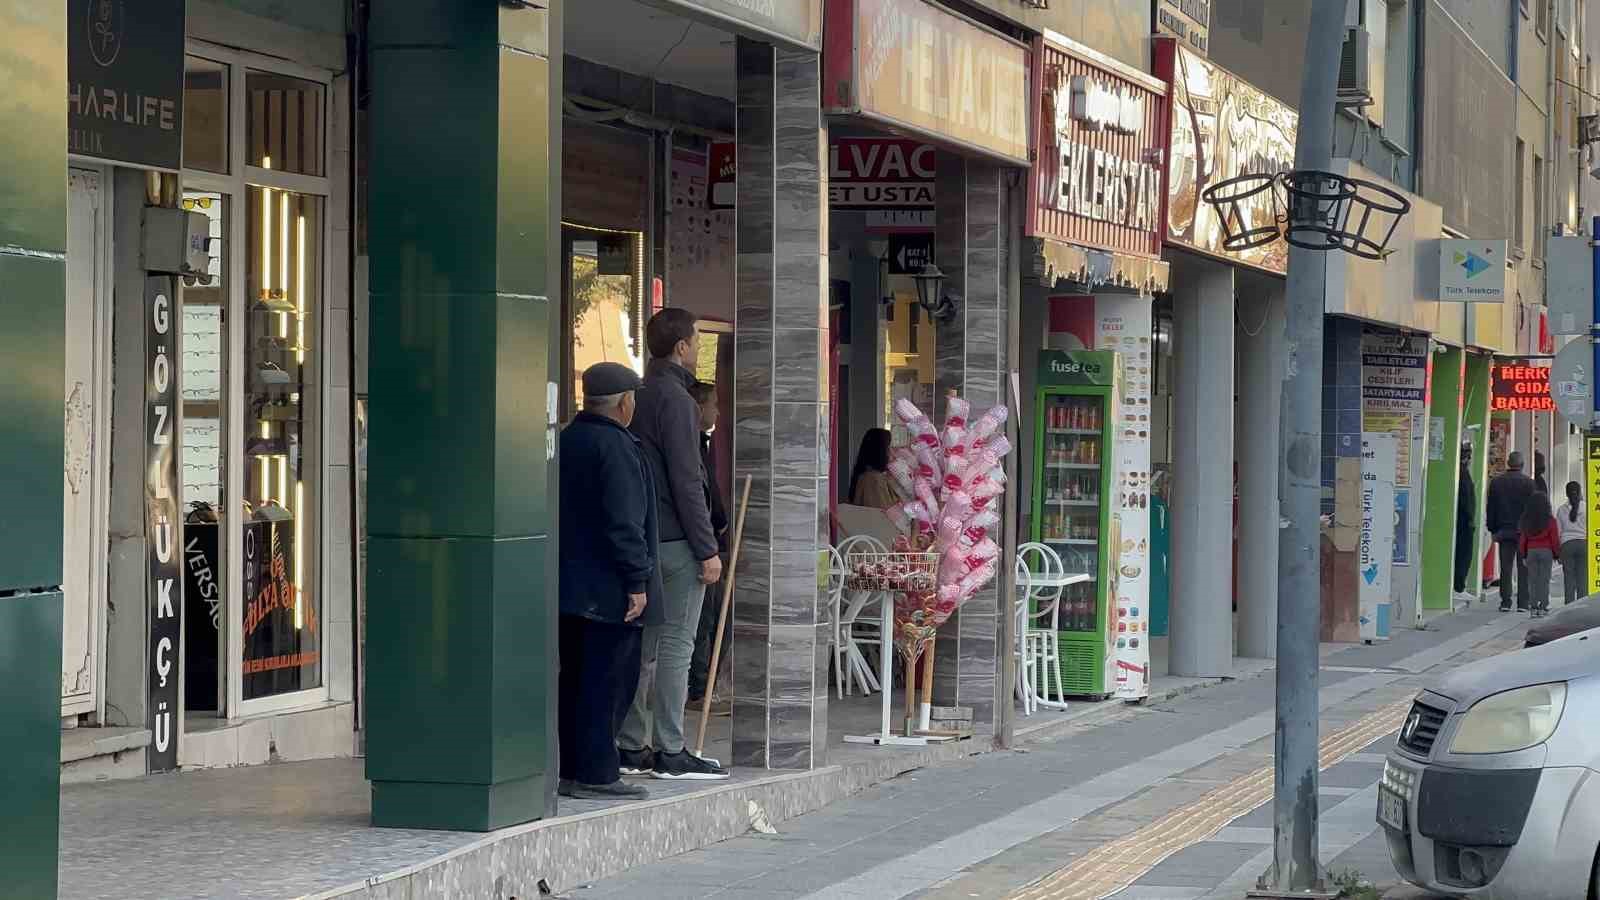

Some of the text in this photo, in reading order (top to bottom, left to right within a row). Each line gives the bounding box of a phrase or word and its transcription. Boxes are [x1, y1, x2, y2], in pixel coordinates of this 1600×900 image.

[1501, 366, 1551, 380] HERK
[1496, 396, 1556, 410] BAHAR
[152, 293, 175, 753] GÖZLÜKÇÜ
